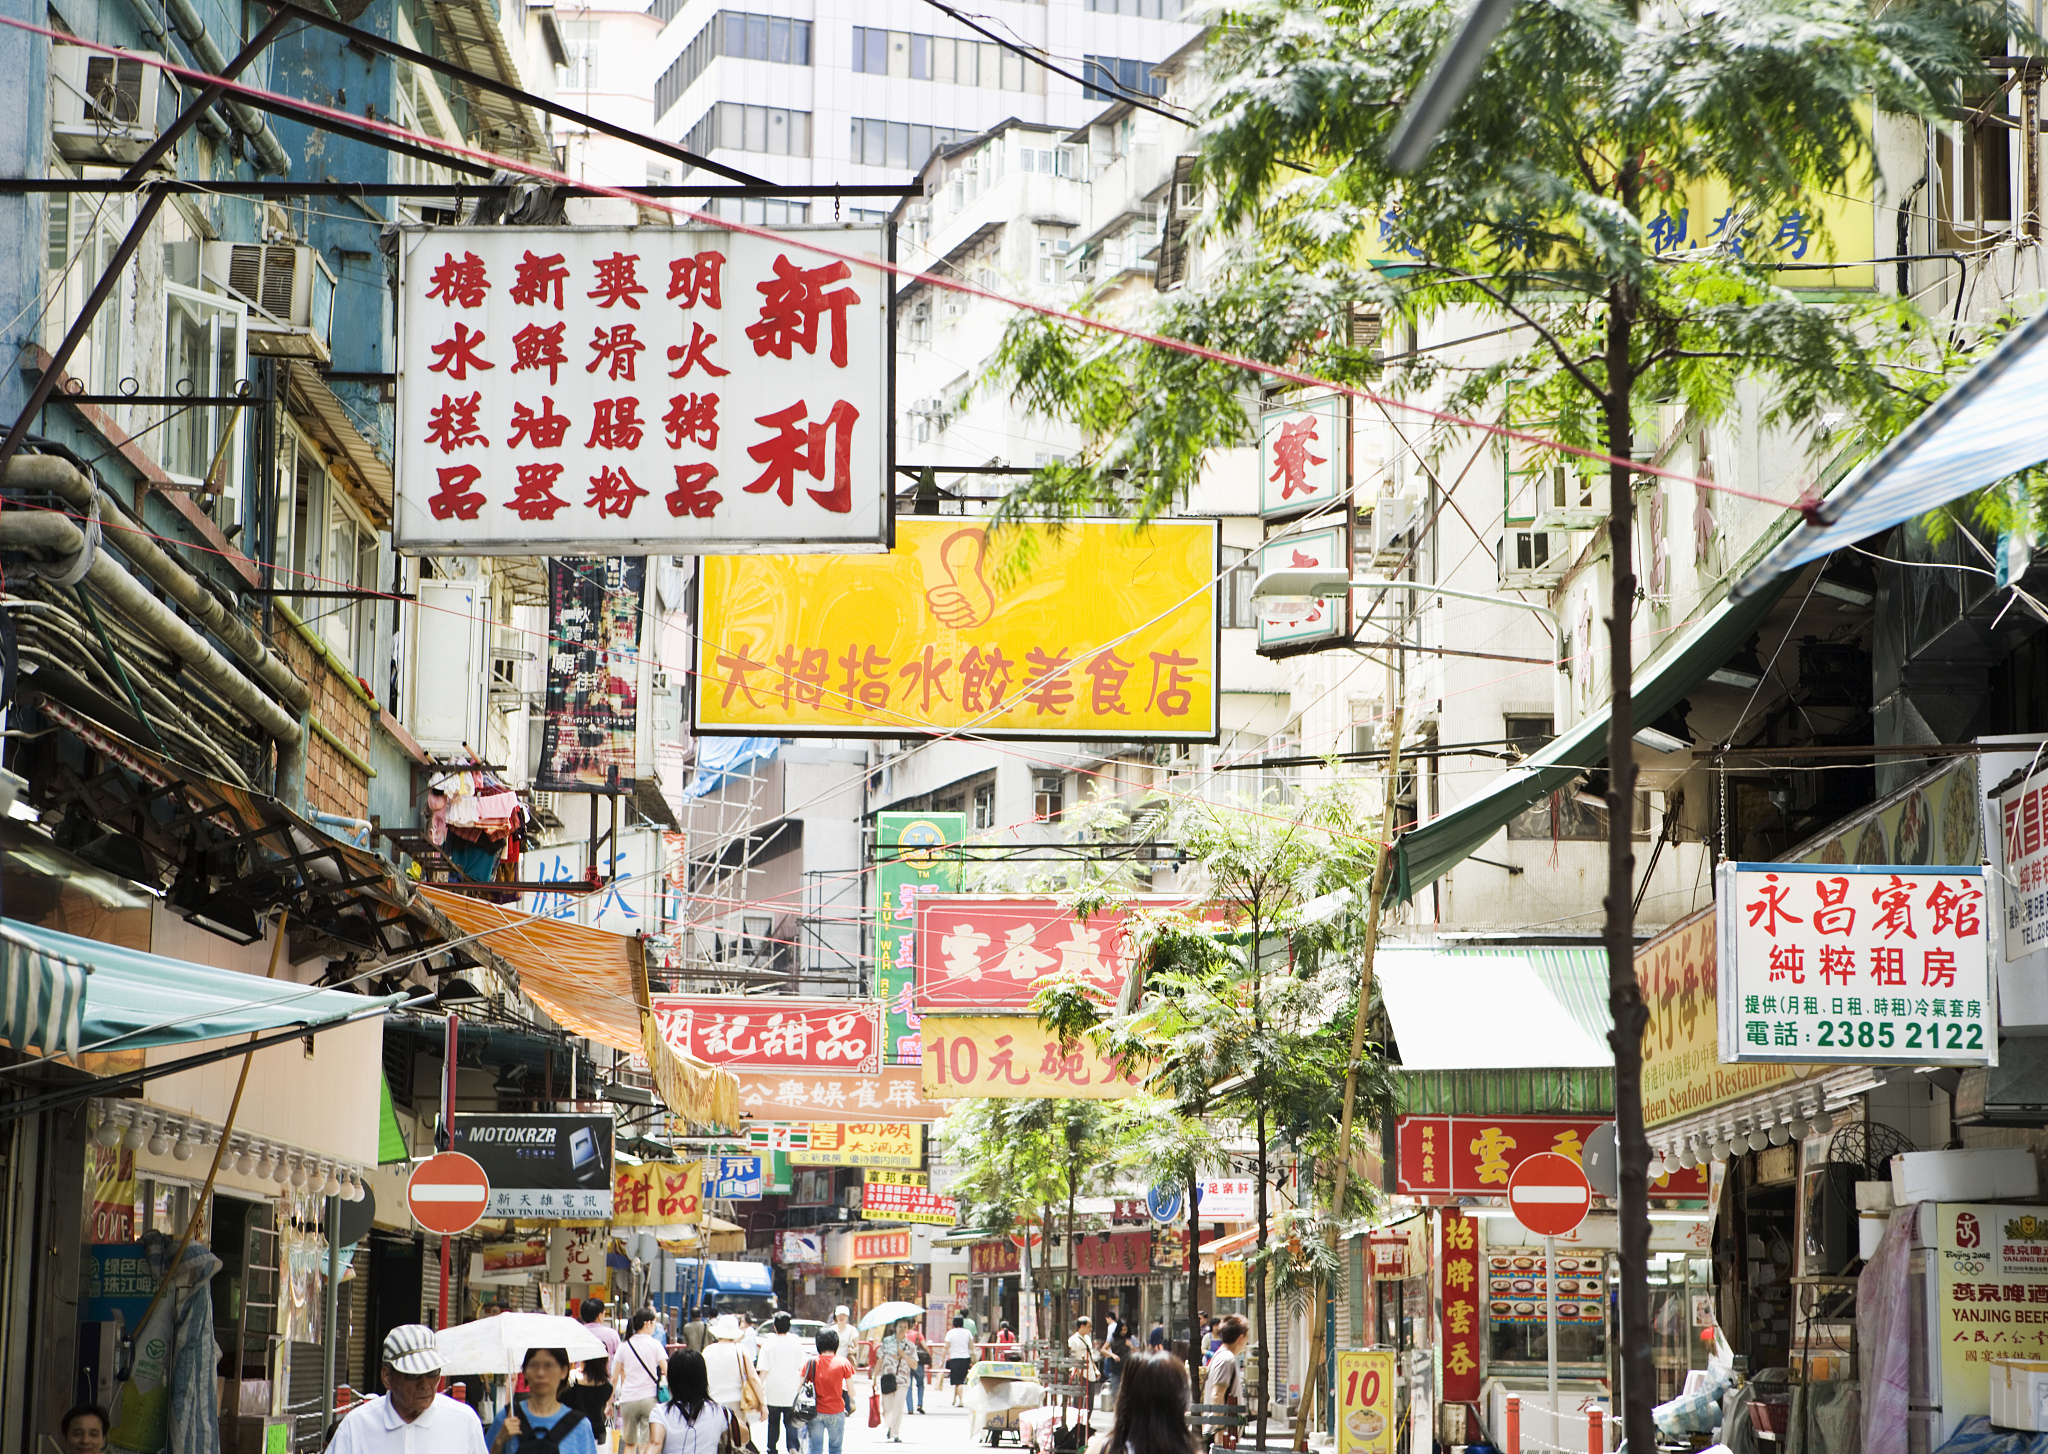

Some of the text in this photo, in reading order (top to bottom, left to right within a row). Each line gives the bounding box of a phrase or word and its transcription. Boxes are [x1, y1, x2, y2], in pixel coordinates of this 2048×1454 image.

[423, 250, 496, 522] 糖水糕品
[503, 249, 571, 521] 新鮮油器
[584, 250, 650, 520] 爽滑腸粉
[662, 249, 731, 519] 明火粥品
[742, 253, 861, 514] 新利
[715, 642, 1199, 717] 大拇指水餃美食店
[1746, 873, 1984, 940] 永昌賓館
[880, 940, 892, 970] WAH
[1768, 943, 1958, 988] 純粹租房
[1905, 1022, 1984, 1050] 2122
[1669, 1079, 1713, 1117] Seafood
[1716, 1062, 1787, 1099] Restaurant
[469, 1127, 558, 1143] MOTOKRZR
[848, 1141, 913, 1155] 大酒店
[496, 1207, 604, 1217] NEW TIN HUNG TELECOM
[497, 1192, 598, 1208] 新天雄電訊
[614, 1172, 698, 1217] 甜品
[1971, 1251, 1991, 1260] 2008
[1445, 1216, 1477, 1377] 招牌雲吞
[1952, 1282, 2048, 1304] 燕京啤酒
[1952, 1308, 2011, 1323] YANJING
[1344, 1369, 1381, 1407] 10
